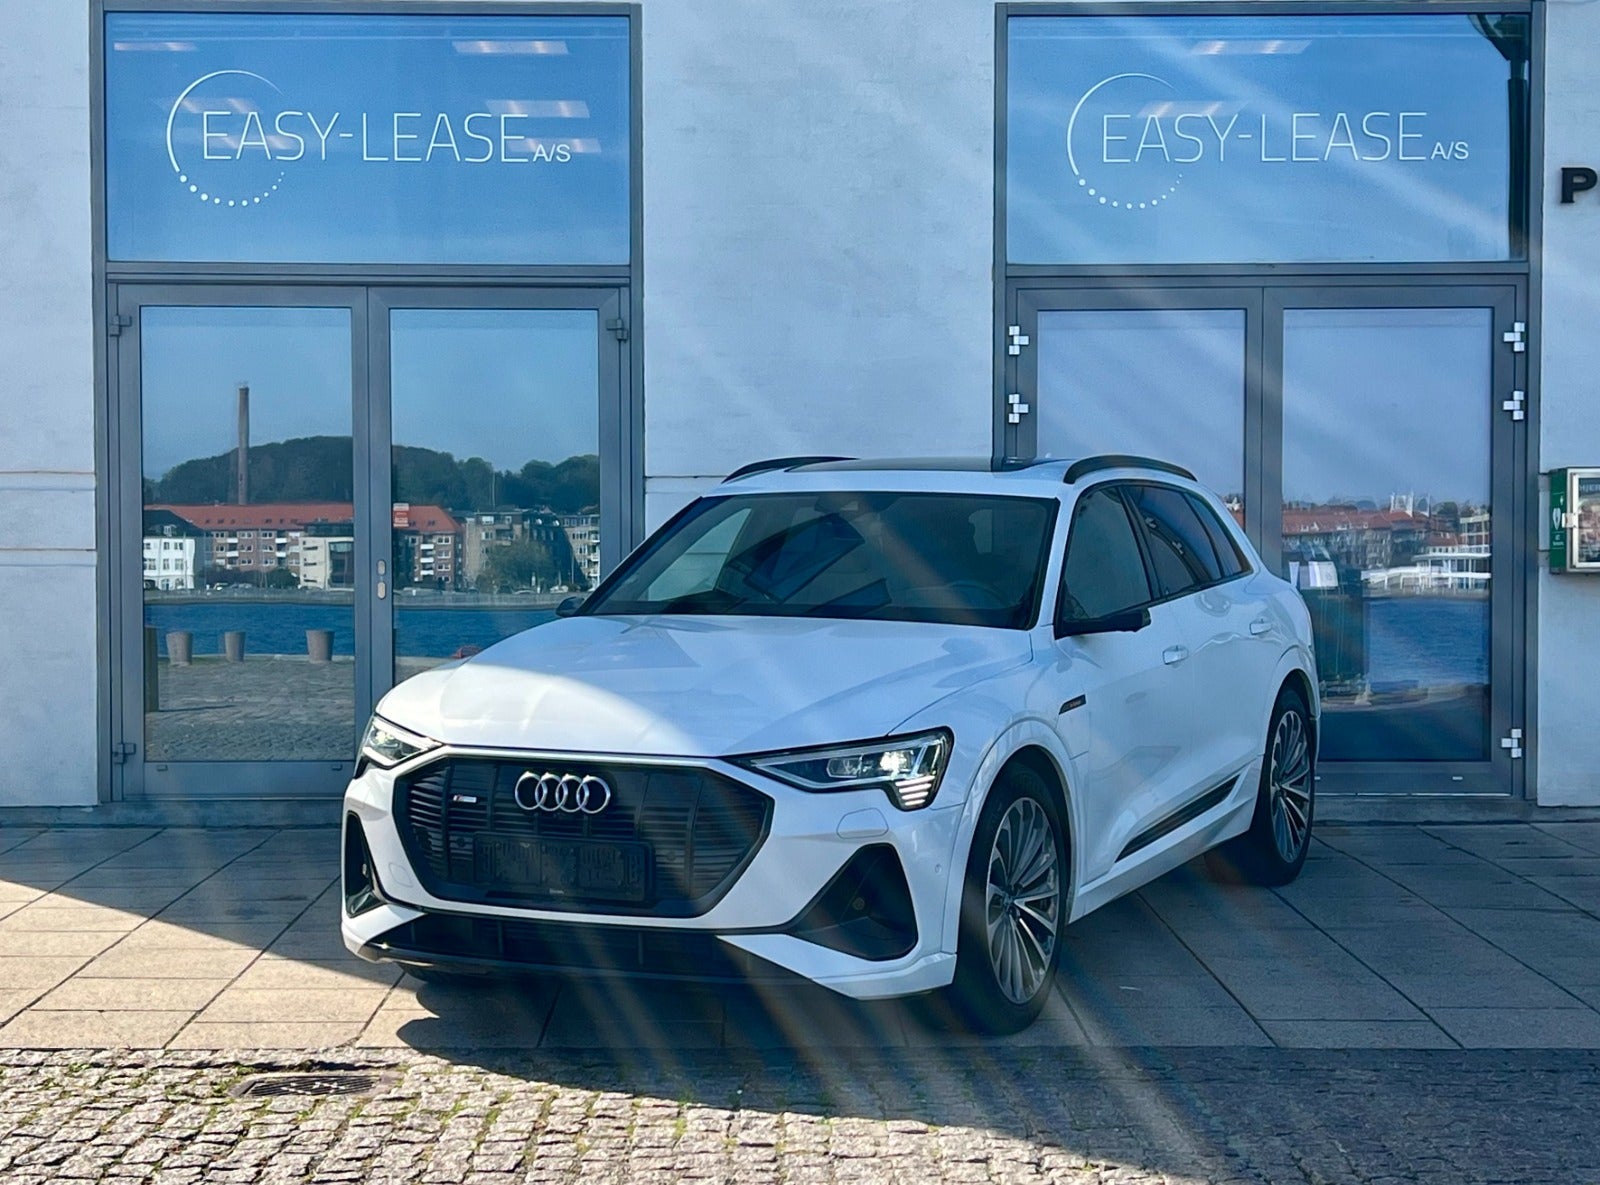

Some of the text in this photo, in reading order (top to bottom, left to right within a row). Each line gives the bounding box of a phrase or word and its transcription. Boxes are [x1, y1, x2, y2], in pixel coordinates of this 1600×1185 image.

[202, 110, 572, 163] EASY-LEASE A/S
[1102, 111, 1470, 164] EASY-LEASE A/S
[1560, 167, 1598, 204] P
